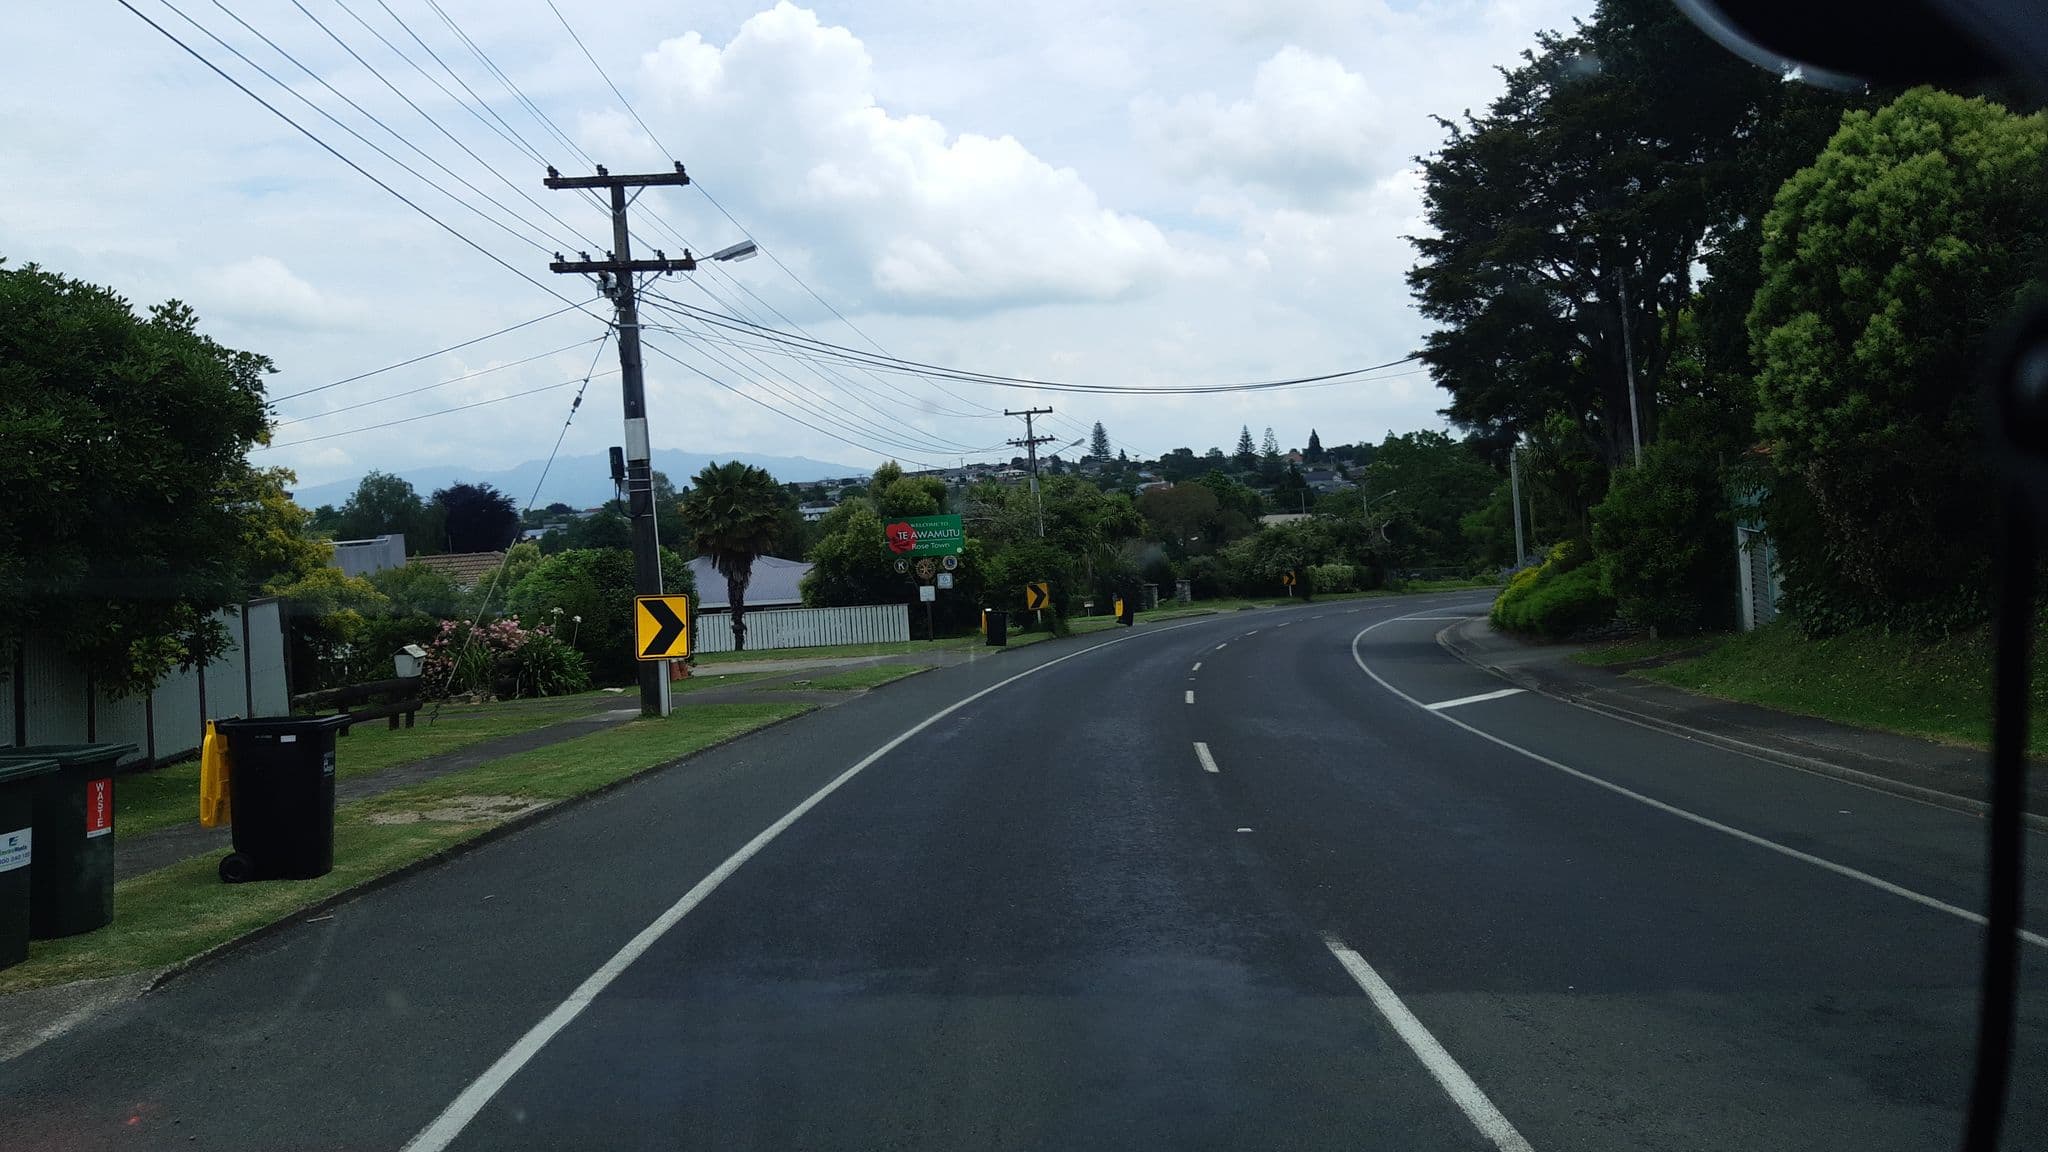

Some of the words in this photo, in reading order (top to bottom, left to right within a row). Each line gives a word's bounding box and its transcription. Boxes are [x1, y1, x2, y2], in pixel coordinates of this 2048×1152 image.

[897, 531, 908, 540] TE
[910, 529, 960, 539] AWAMUTU
[898, 562, 905, 570] K
[96, 782, 104, 827] WASTE
